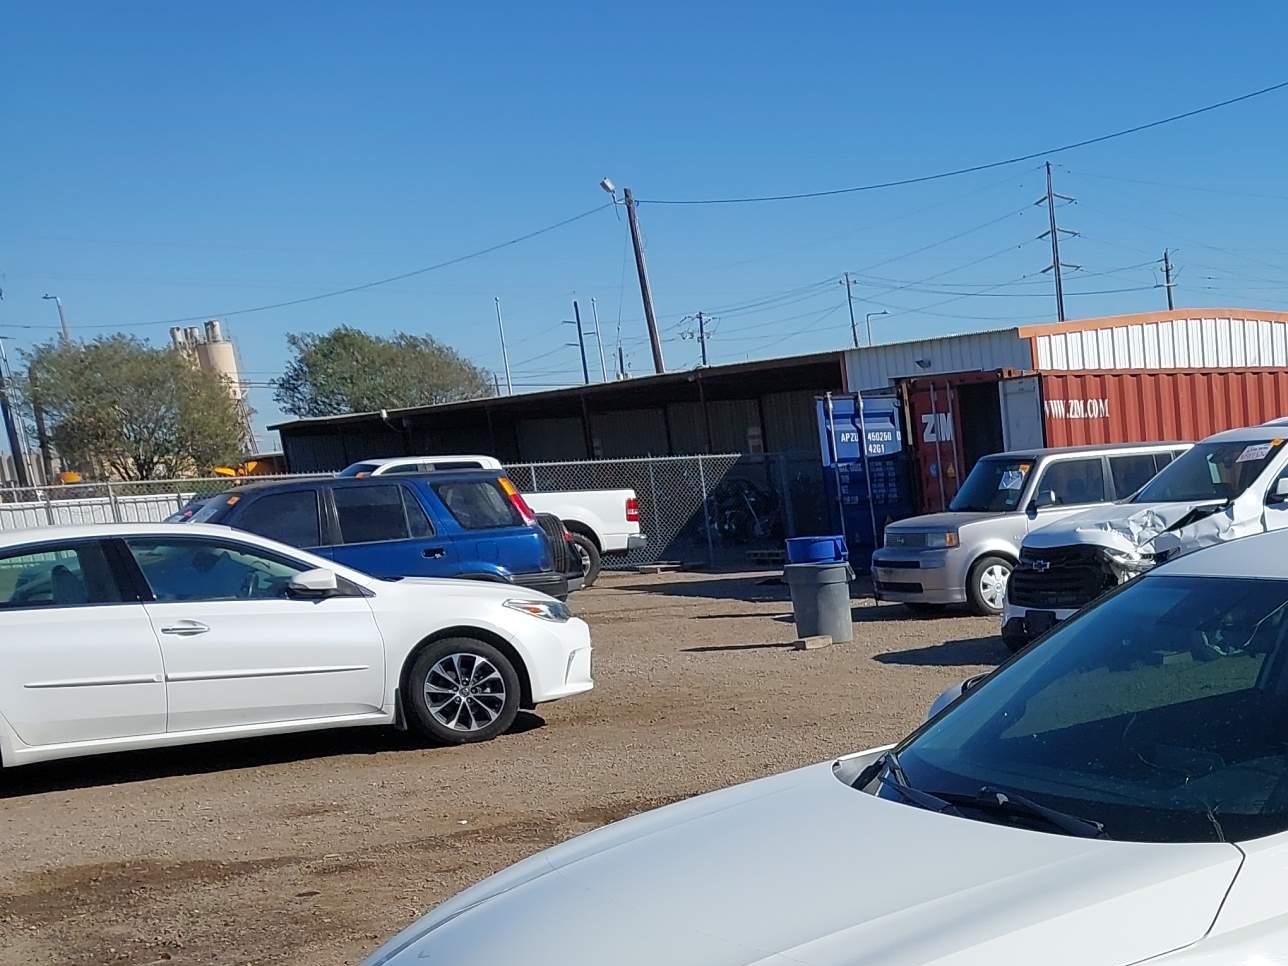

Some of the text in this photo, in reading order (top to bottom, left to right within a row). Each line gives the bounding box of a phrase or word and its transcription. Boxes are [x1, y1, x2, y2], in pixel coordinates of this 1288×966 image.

[921, 412, 954, 443] ZIM
[840, 432, 859, 443] APZU
[868, 444, 885, 454] 42G1
